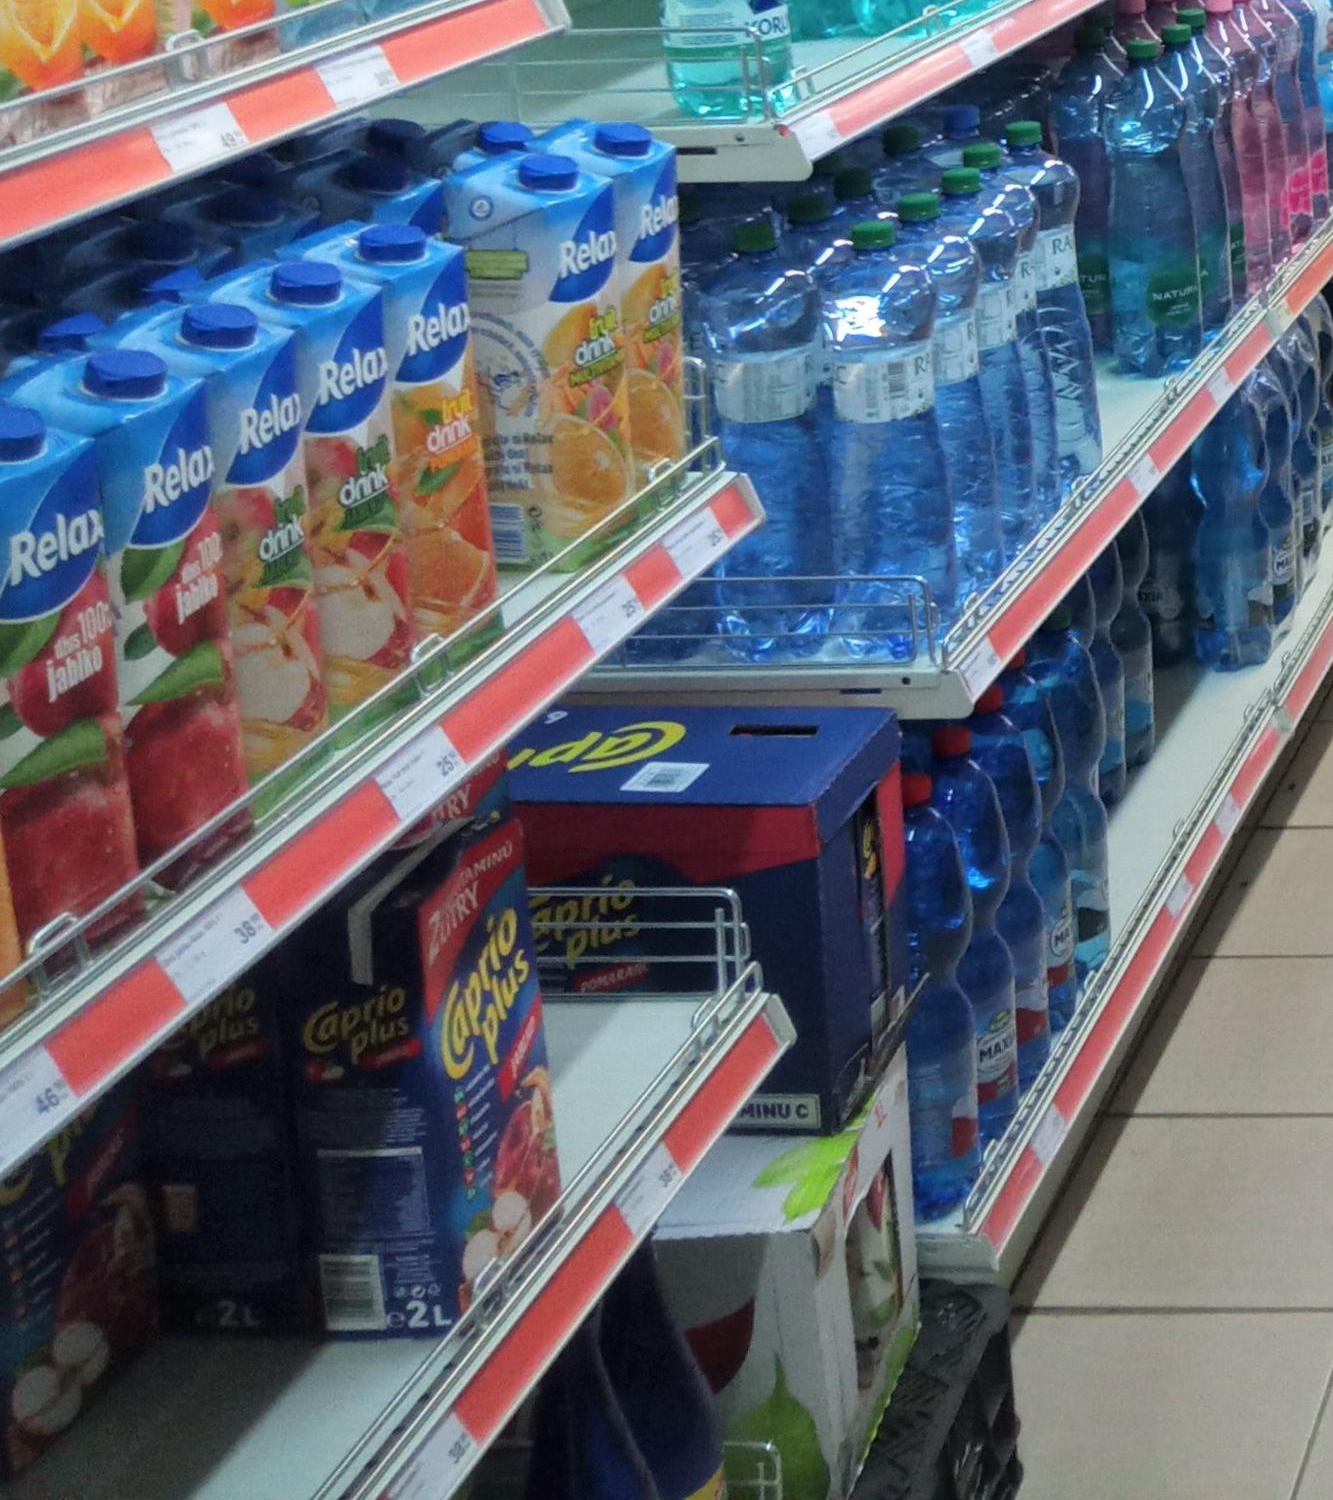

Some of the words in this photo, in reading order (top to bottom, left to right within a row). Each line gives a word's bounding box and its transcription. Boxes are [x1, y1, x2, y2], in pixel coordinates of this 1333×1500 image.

[425, 414, 472, 456] drink
[143, 444, 217, 515] Relax
[338, 461, 390, 509] drink
[7, 508, 105, 588] Relax
[302, 984, 407, 1056] Caprio
[441, 907, 518, 1081] Caprio
[482, 948, 530, 1066] plus
